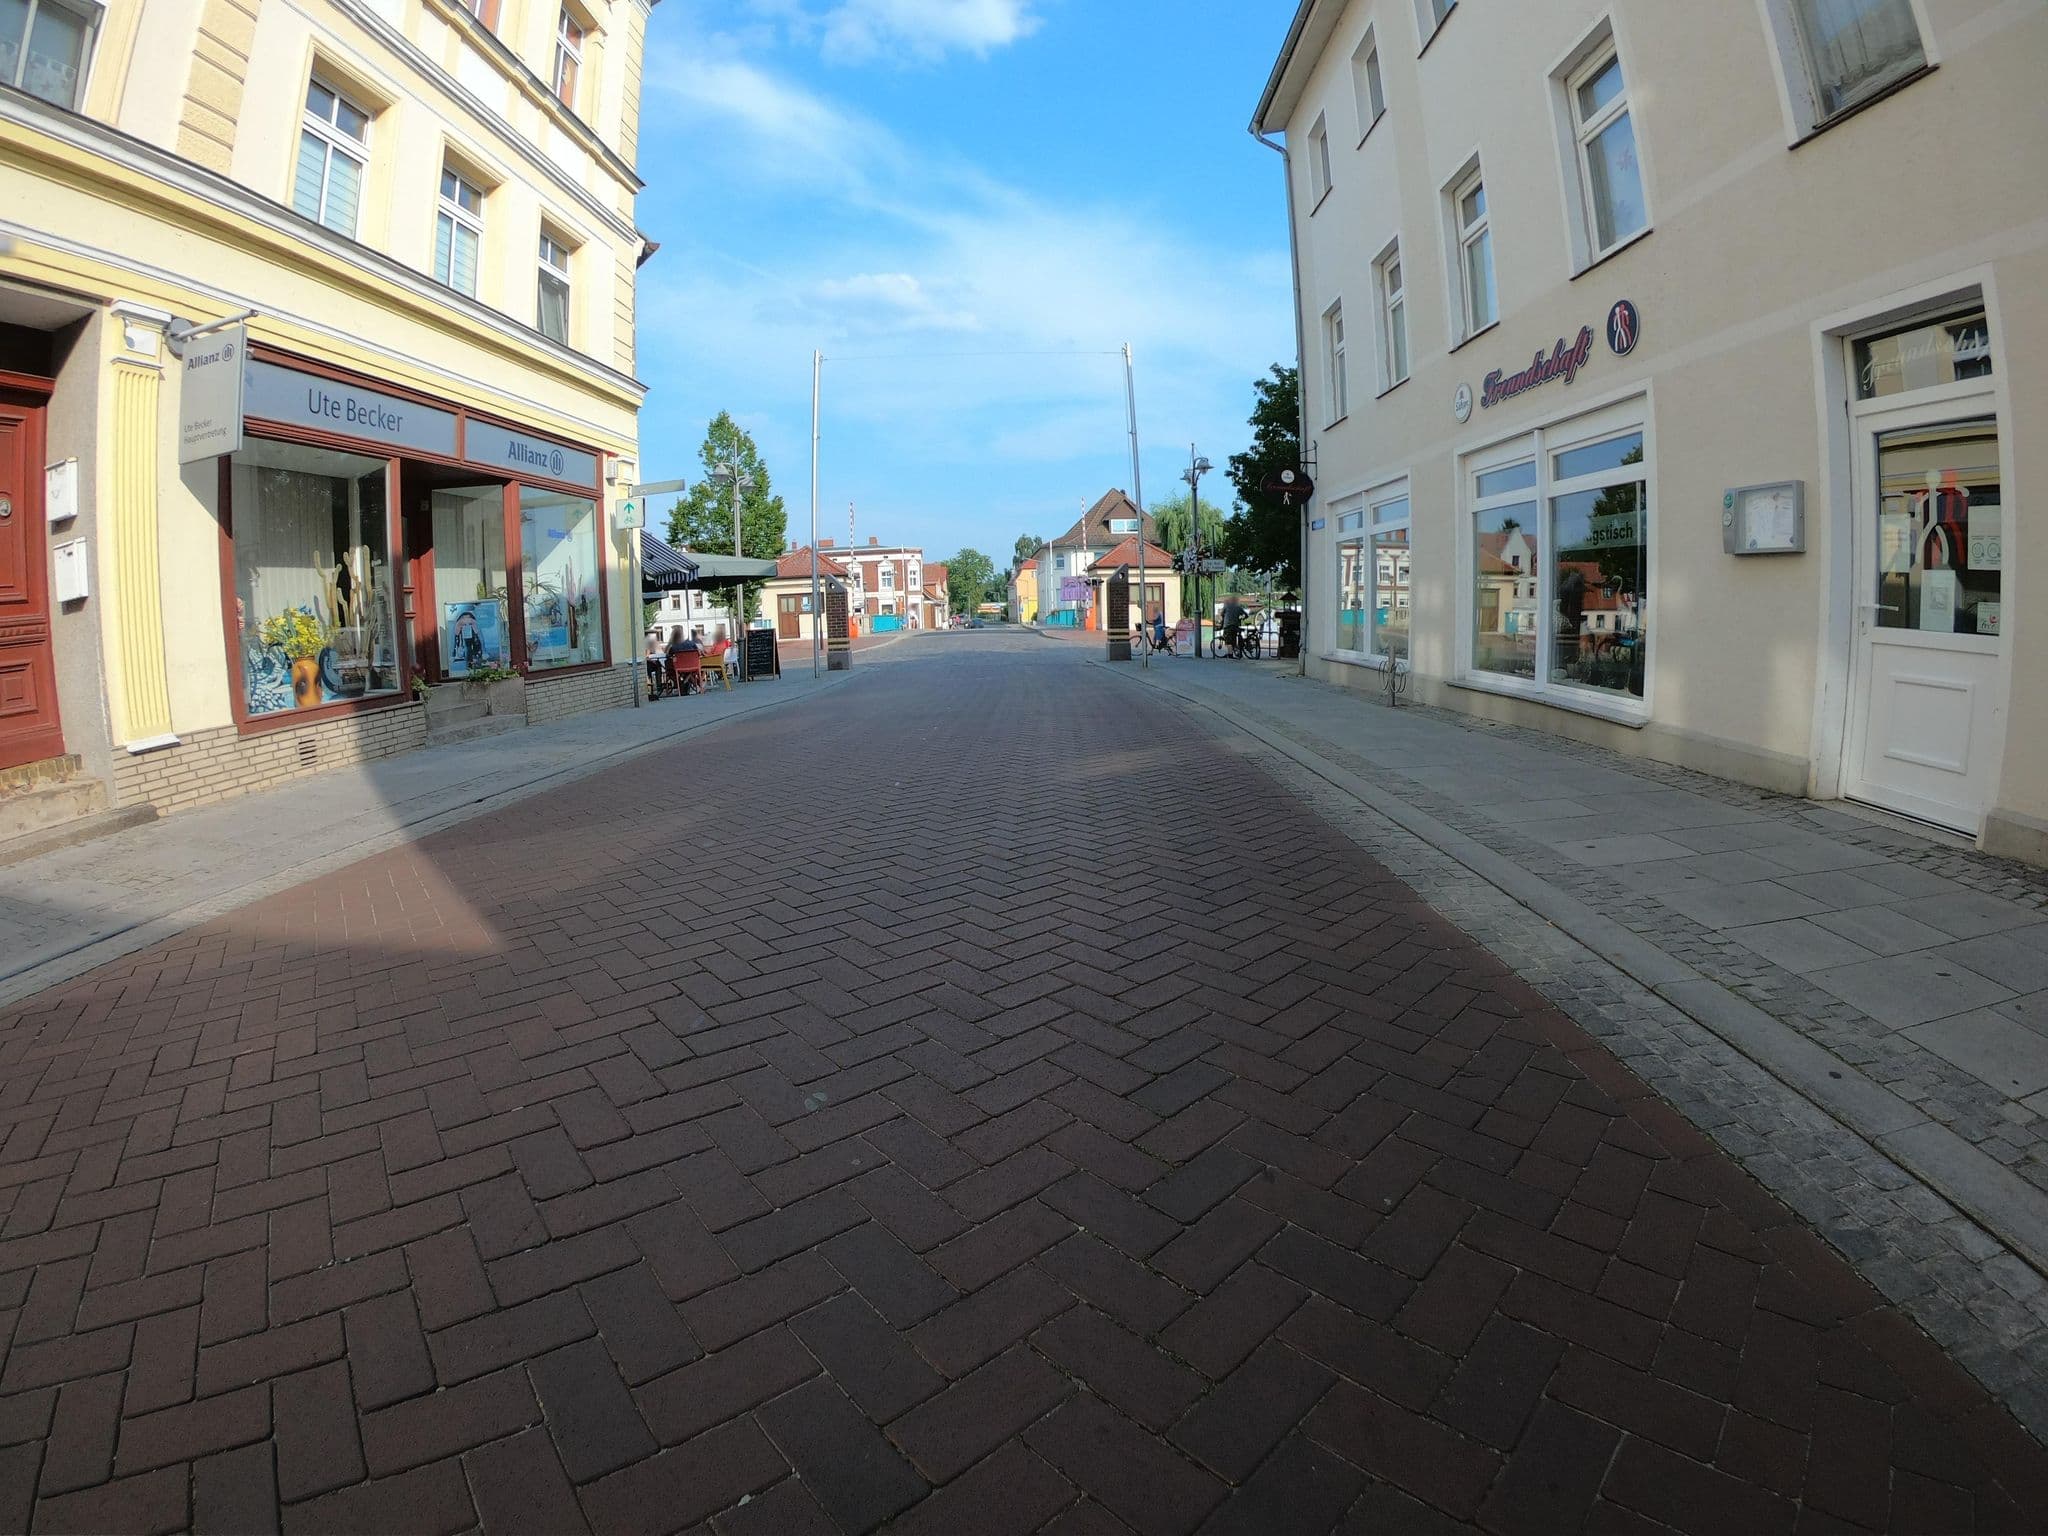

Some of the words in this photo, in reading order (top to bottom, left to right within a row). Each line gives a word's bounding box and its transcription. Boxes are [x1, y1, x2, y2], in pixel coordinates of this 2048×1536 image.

[187, 351, 220, 370] Allianz
[1481, 325, 1594, 408] Freundschaft
[309, 389, 340, 419] Ute
[346, 398, 403, 432] Becker
[508, 441, 548, 468] Allianz
